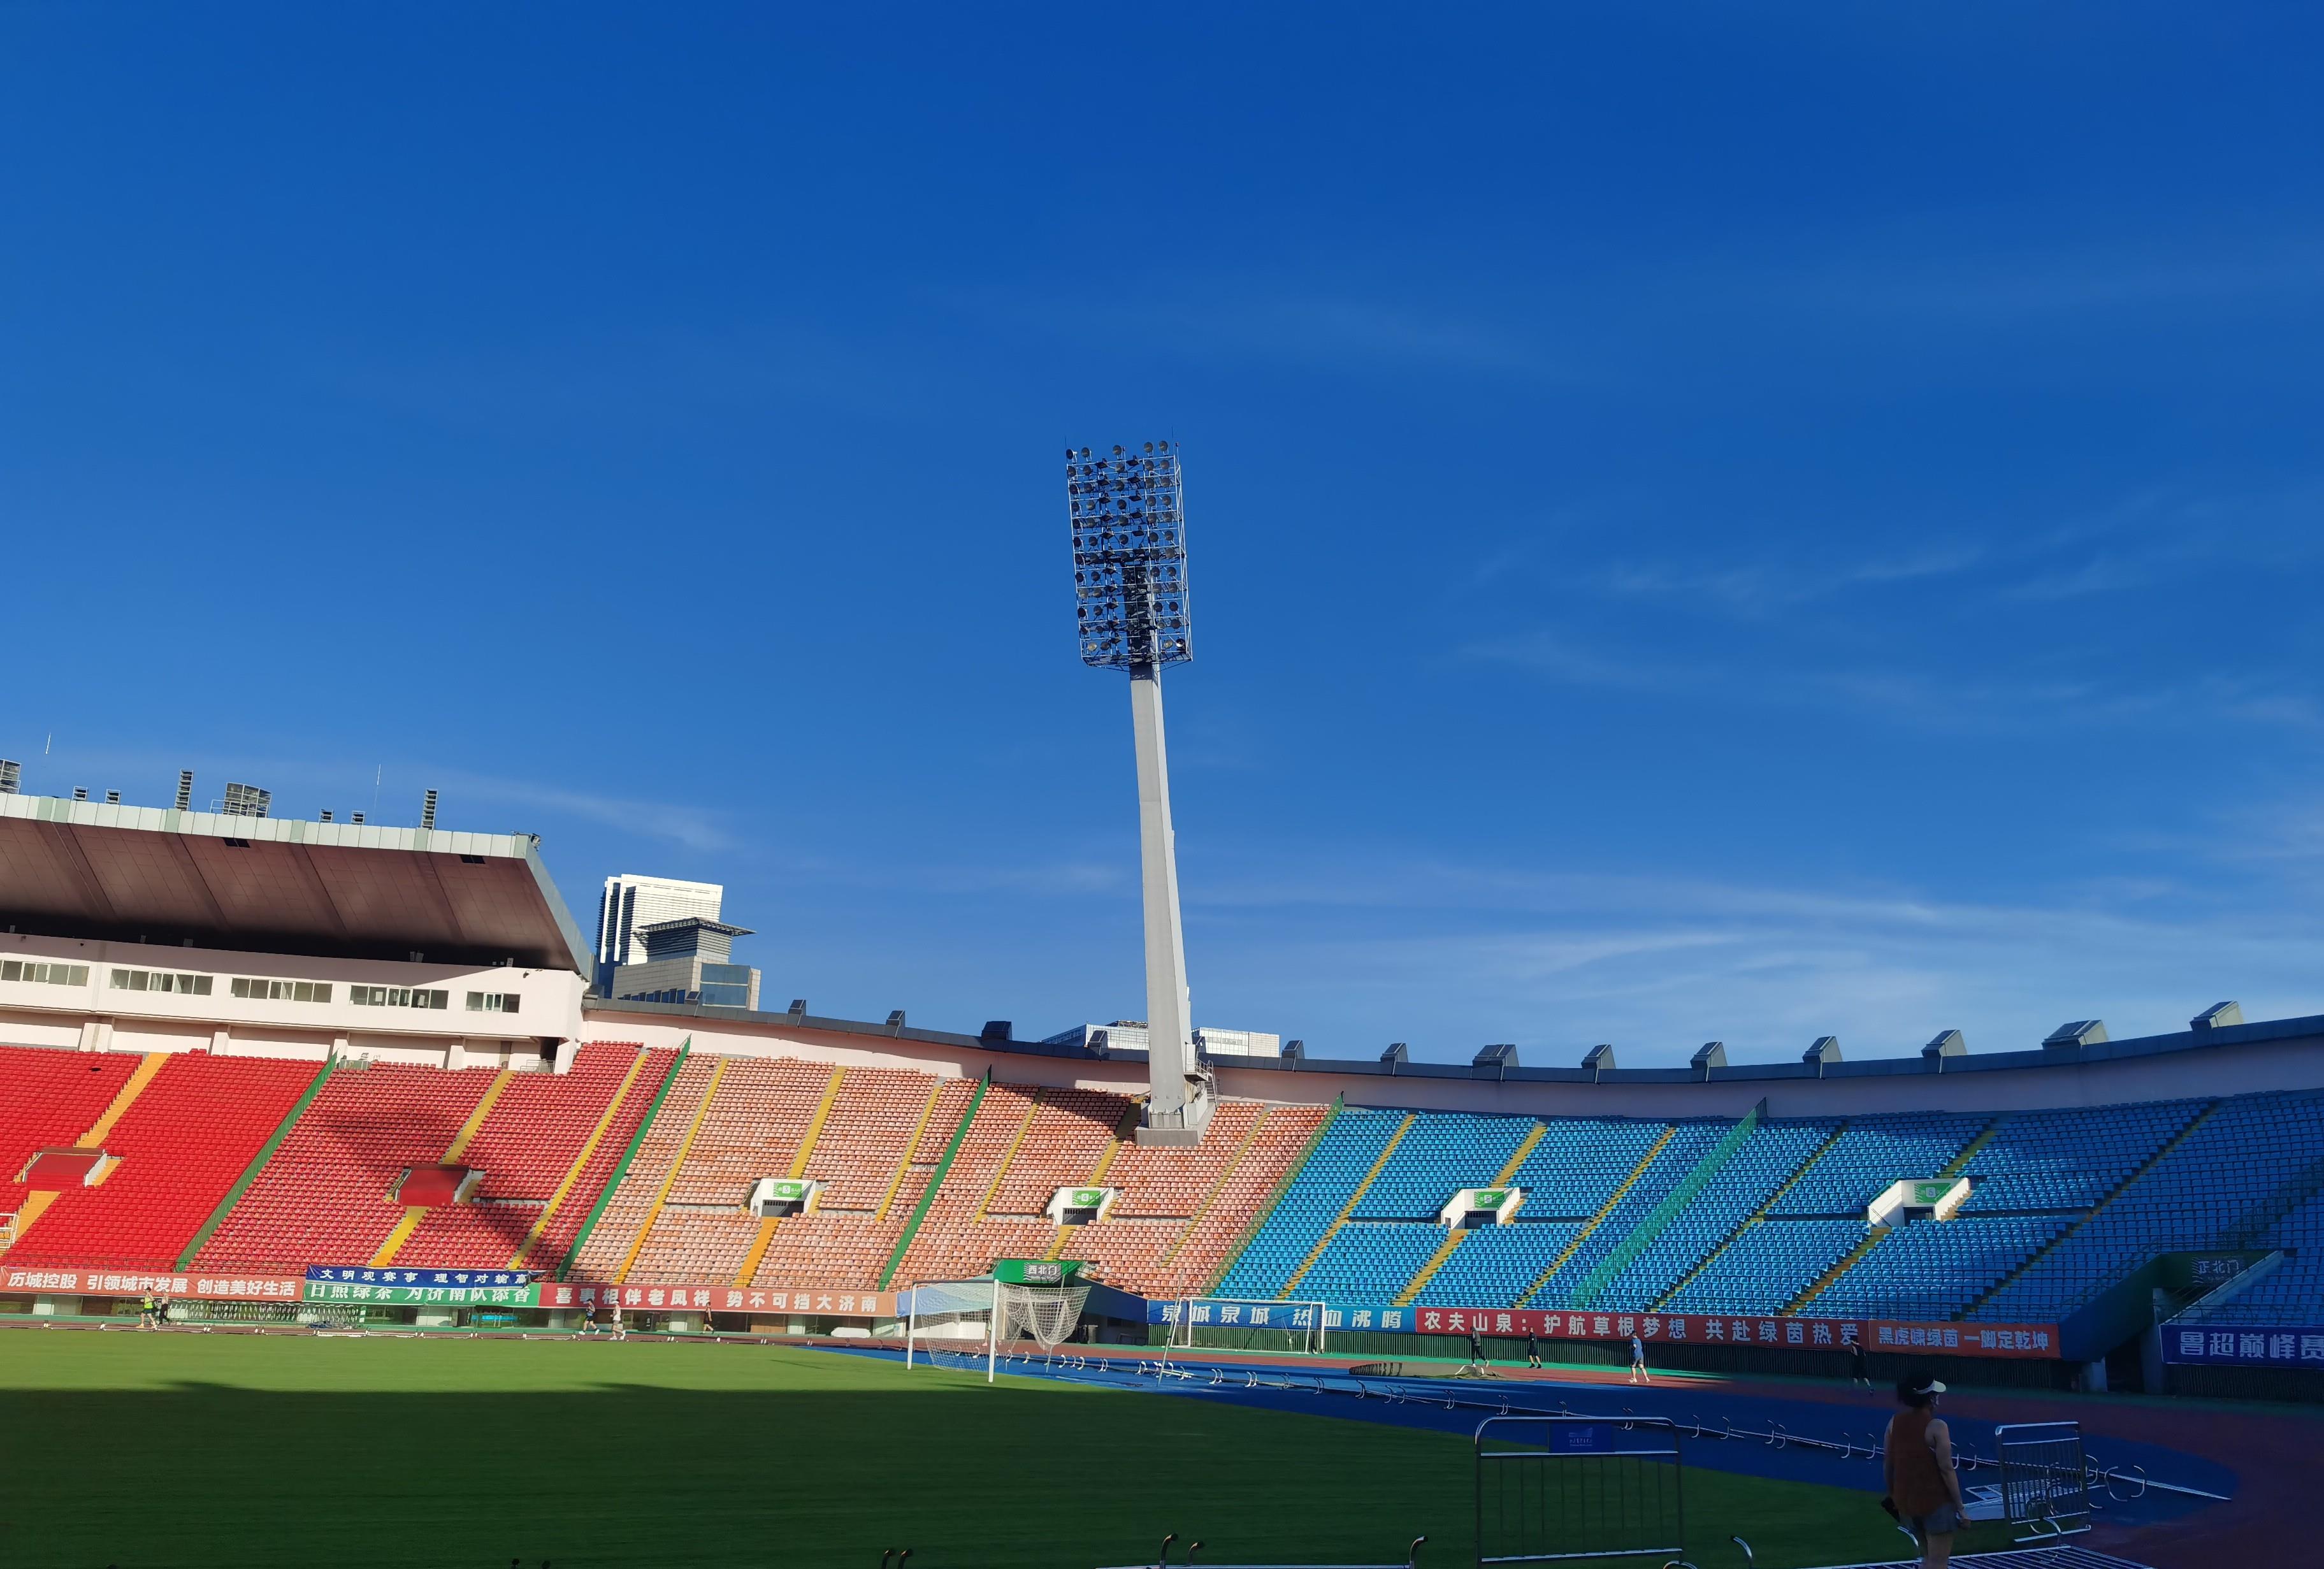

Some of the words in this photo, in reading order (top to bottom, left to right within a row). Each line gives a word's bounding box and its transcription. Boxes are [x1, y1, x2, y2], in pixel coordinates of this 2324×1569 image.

[320, 1269, 418, 1283] 文明观赛事
[1028, 1265, 1057, 1275] 西北门
[7, 1271, 78, 1289] 历城控股
[87, 1275, 187, 1293] 引领城市发展
[197, 1278, 296, 1297] 创造美好生活
[556, 1287, 711, 1306] 喜事相伴老凤祥
[726, 1290, 877, 1312] 势不可挡大济南
[1292, 1308, 1402, 1329] 热血沸腾
[1705, 1319, 1858, 1345] 共赴绿茵热爱
[2179, 1331, 2324, 1359] 鲁超巅峰赛
